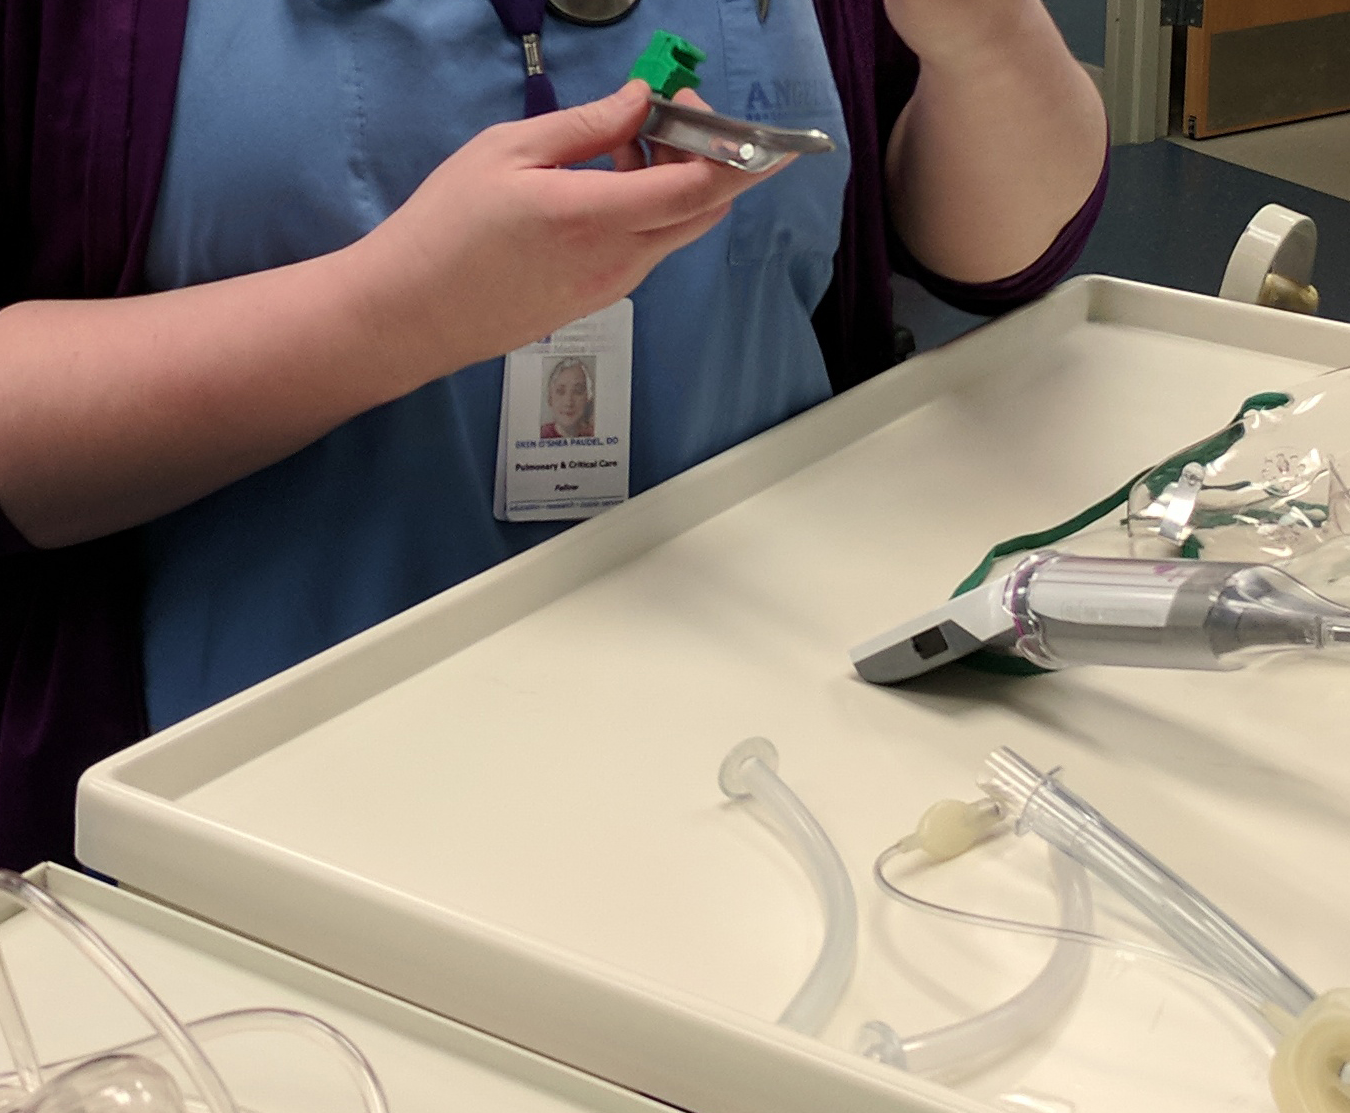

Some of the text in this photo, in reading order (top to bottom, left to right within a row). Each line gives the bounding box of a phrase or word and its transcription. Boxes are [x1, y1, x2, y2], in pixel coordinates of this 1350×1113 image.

[515, 459, 617, 472] Pulmonary & Critical Care
